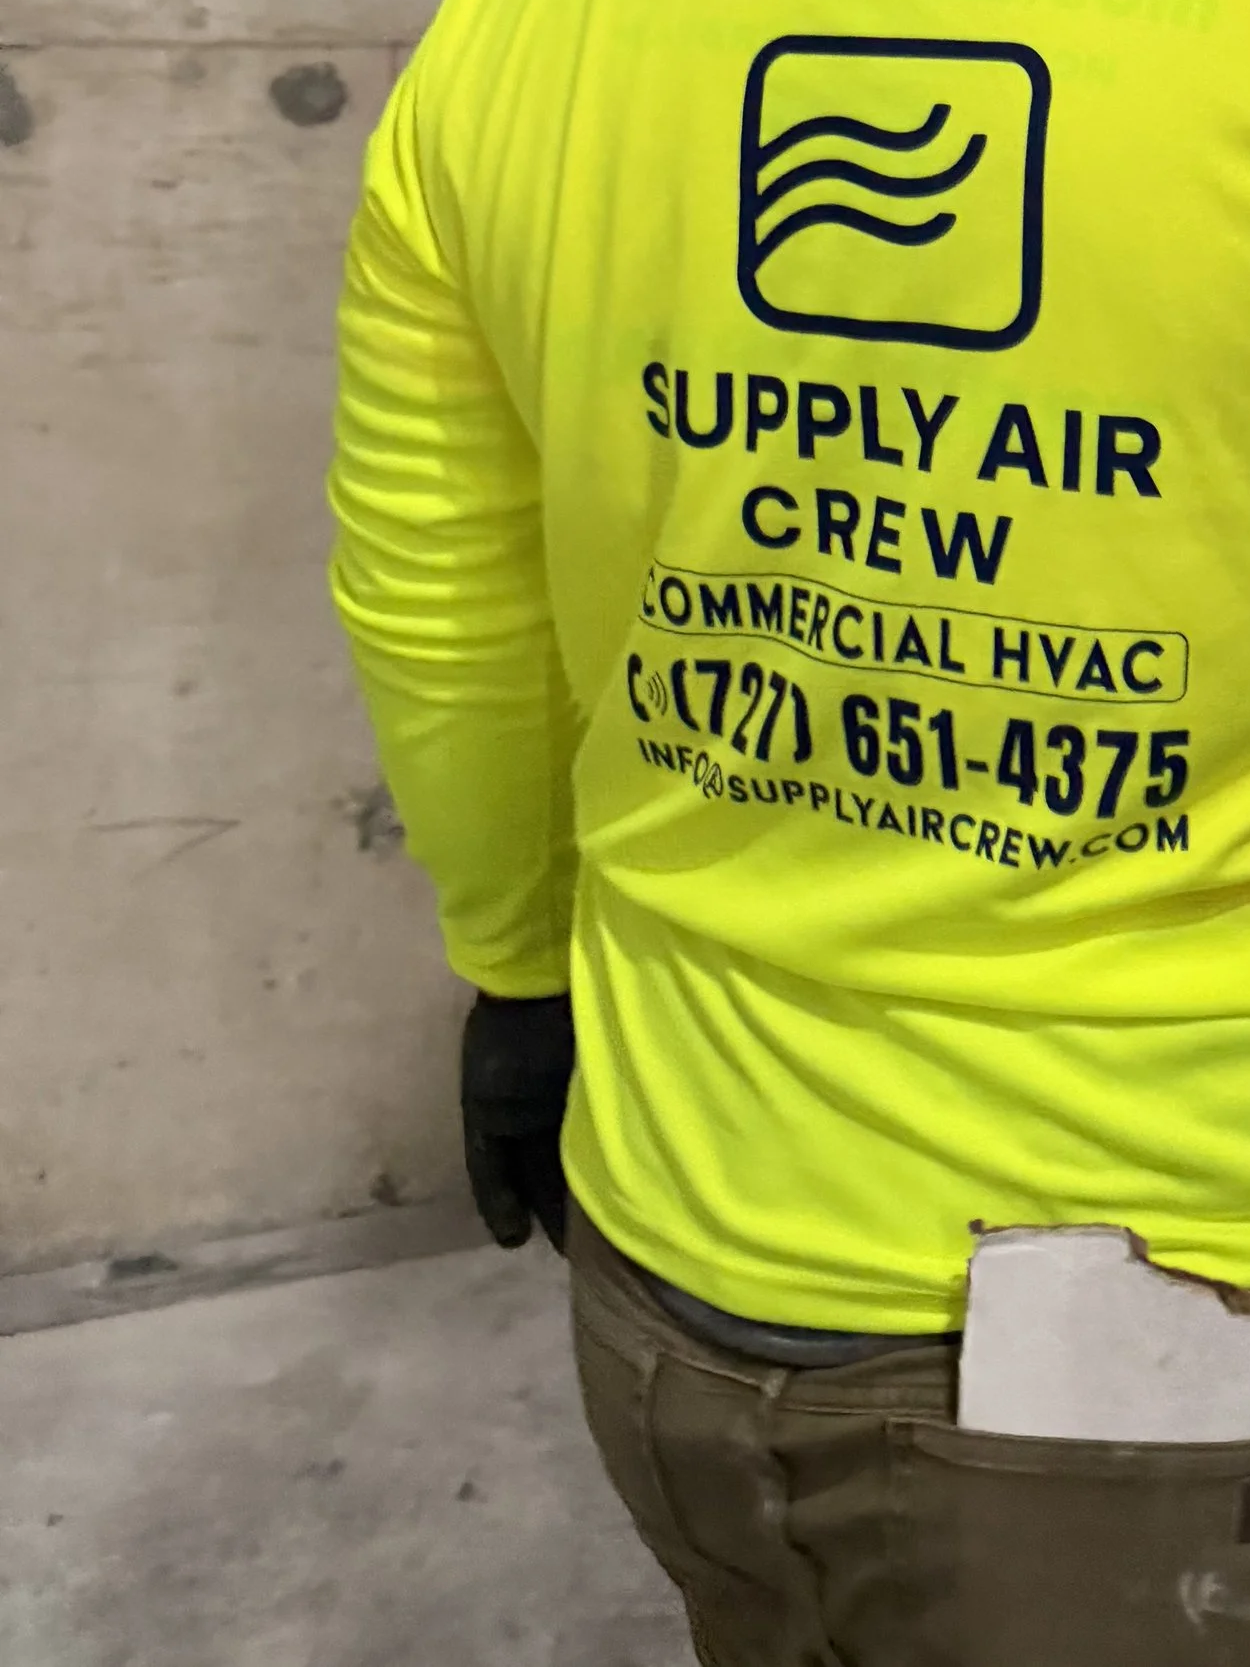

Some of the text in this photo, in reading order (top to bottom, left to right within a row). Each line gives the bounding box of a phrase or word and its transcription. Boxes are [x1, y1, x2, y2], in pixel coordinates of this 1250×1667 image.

[642, 361, 1163, 498] SUPPLY AIR
[741, 485, 1014, 586] CREW
[993, 627, 1166, 695] HVAC
[637, 737, 1190, 871] INFO@SUPPLYAIRCREW.COM
[671, 659, 1190, 820] (727) 651-4375
